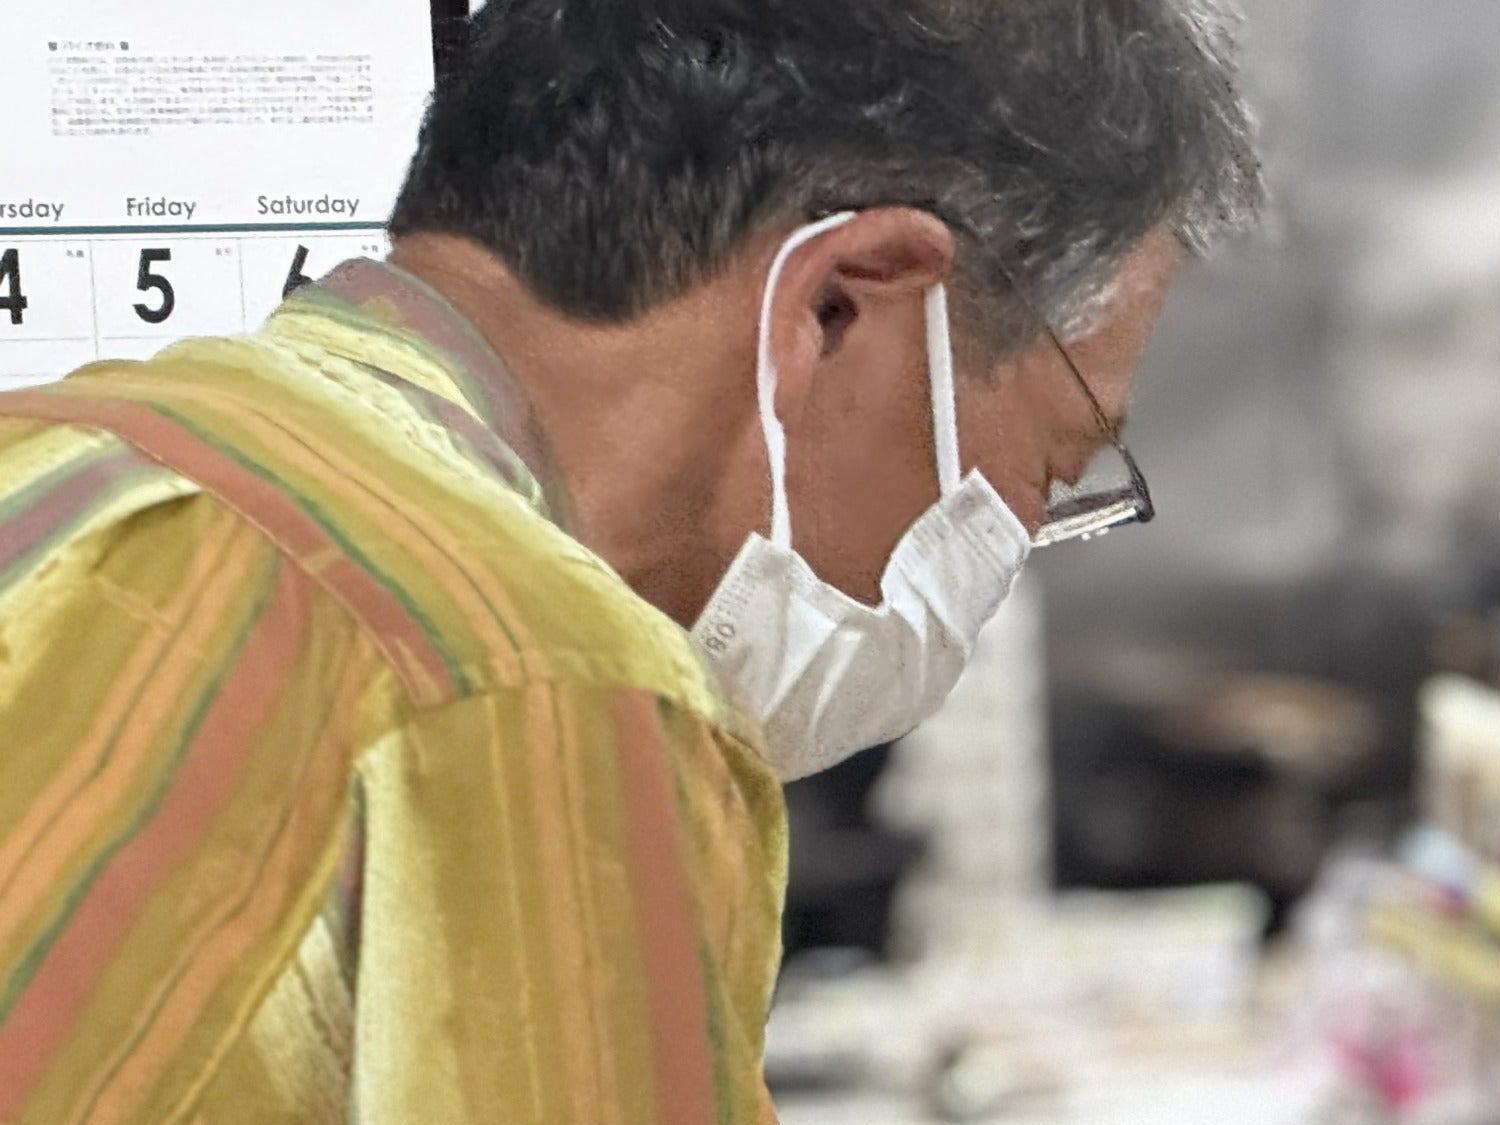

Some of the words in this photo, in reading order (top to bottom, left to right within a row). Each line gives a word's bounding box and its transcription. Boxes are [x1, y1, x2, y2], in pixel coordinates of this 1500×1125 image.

[126, 196, 196, 220] Friday
[257, 194, 360, 217] Saturday
[132, 248, 175, 324] 5
